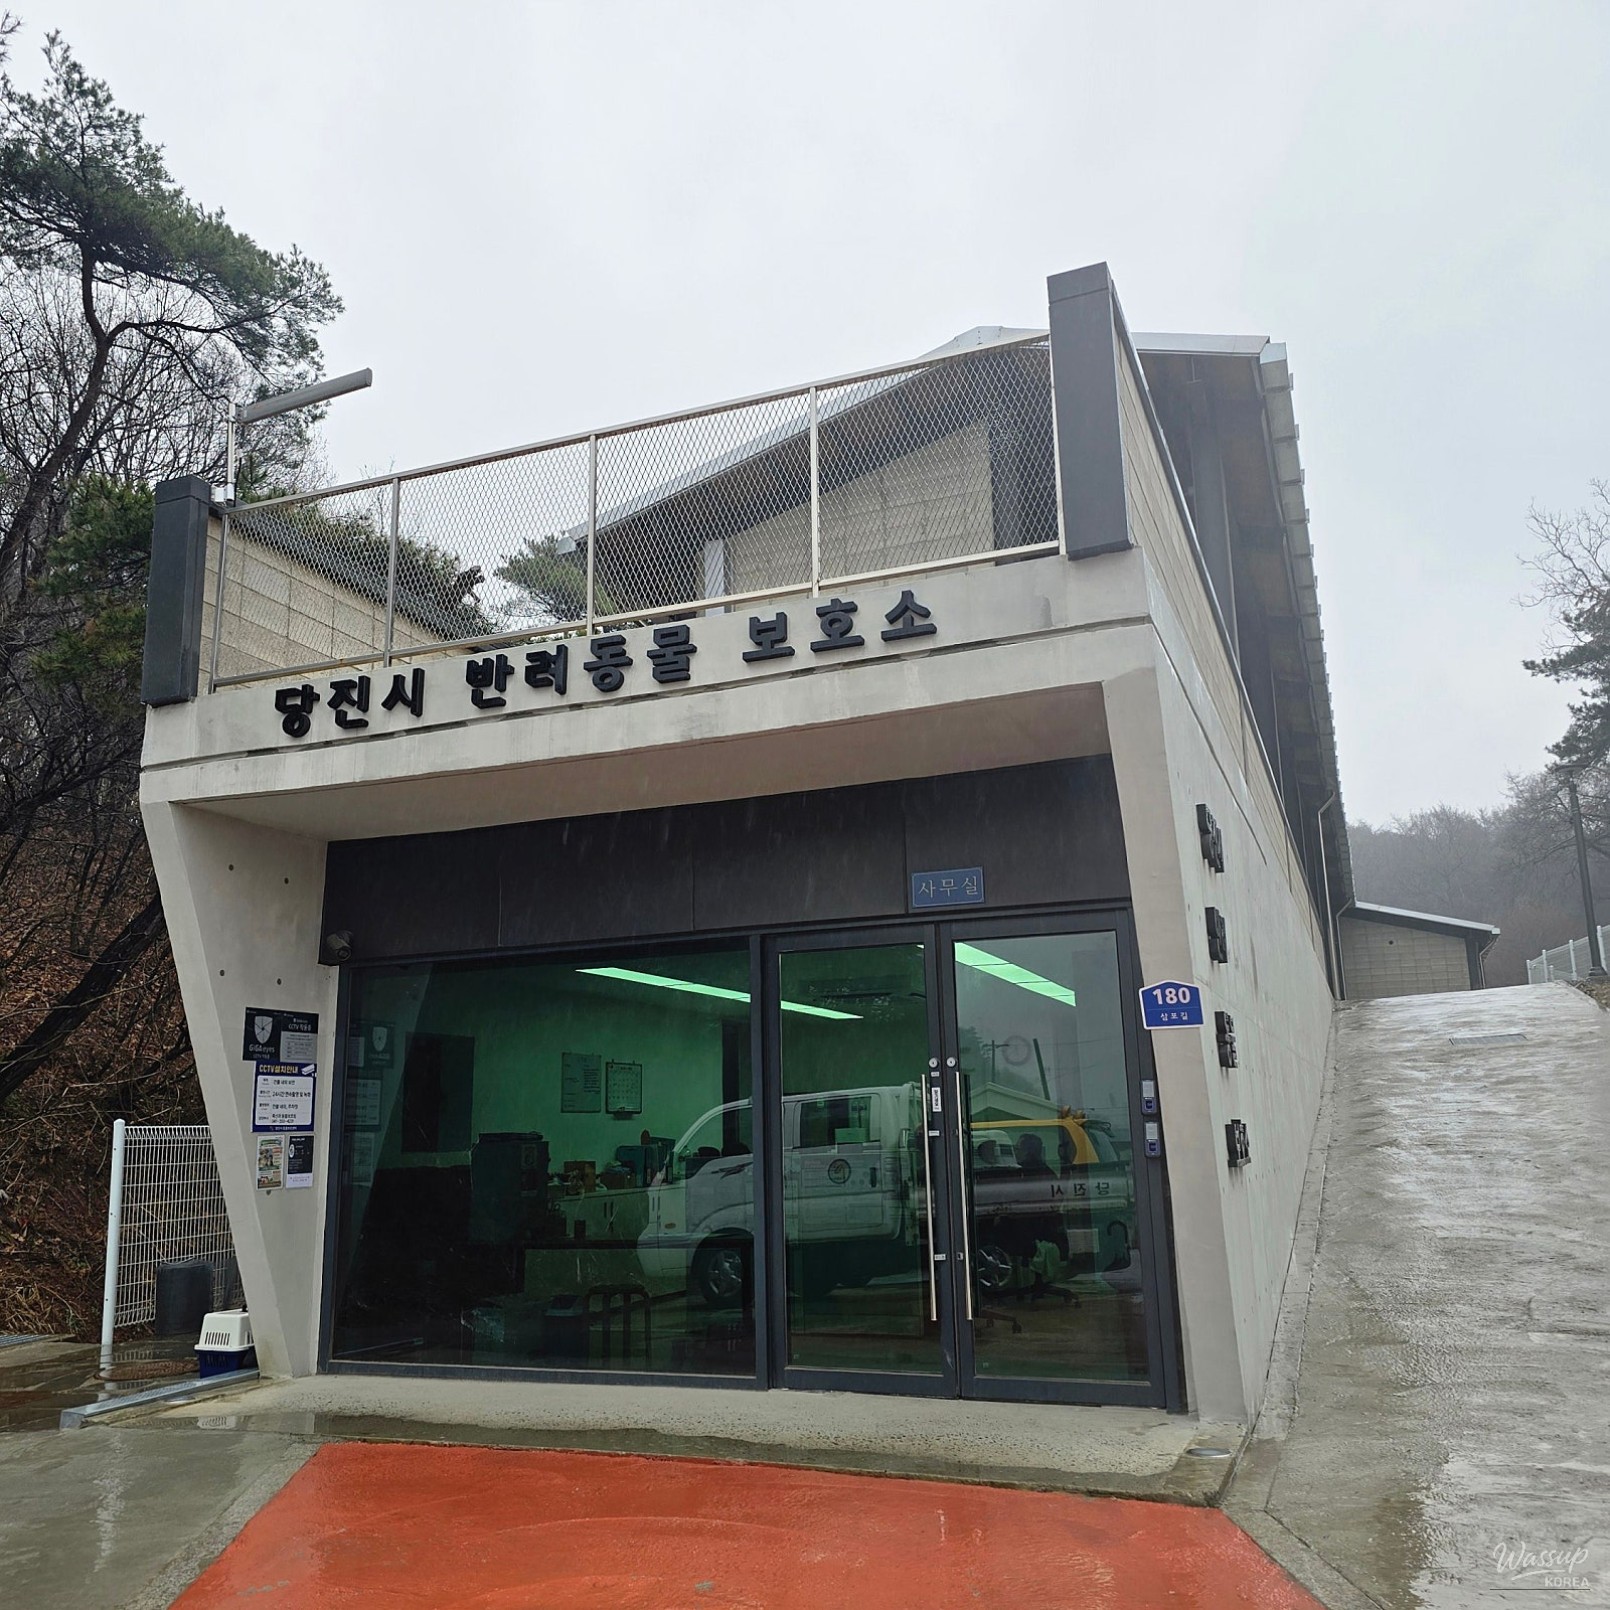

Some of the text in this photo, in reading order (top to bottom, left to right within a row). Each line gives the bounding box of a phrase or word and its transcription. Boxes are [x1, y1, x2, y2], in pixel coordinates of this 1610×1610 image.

[273, 590, 938, 738] 당진시 반려동물 보호소
[918, 876, 979, 898] 사무실
[1152, 987, 1190, 1005] 180
